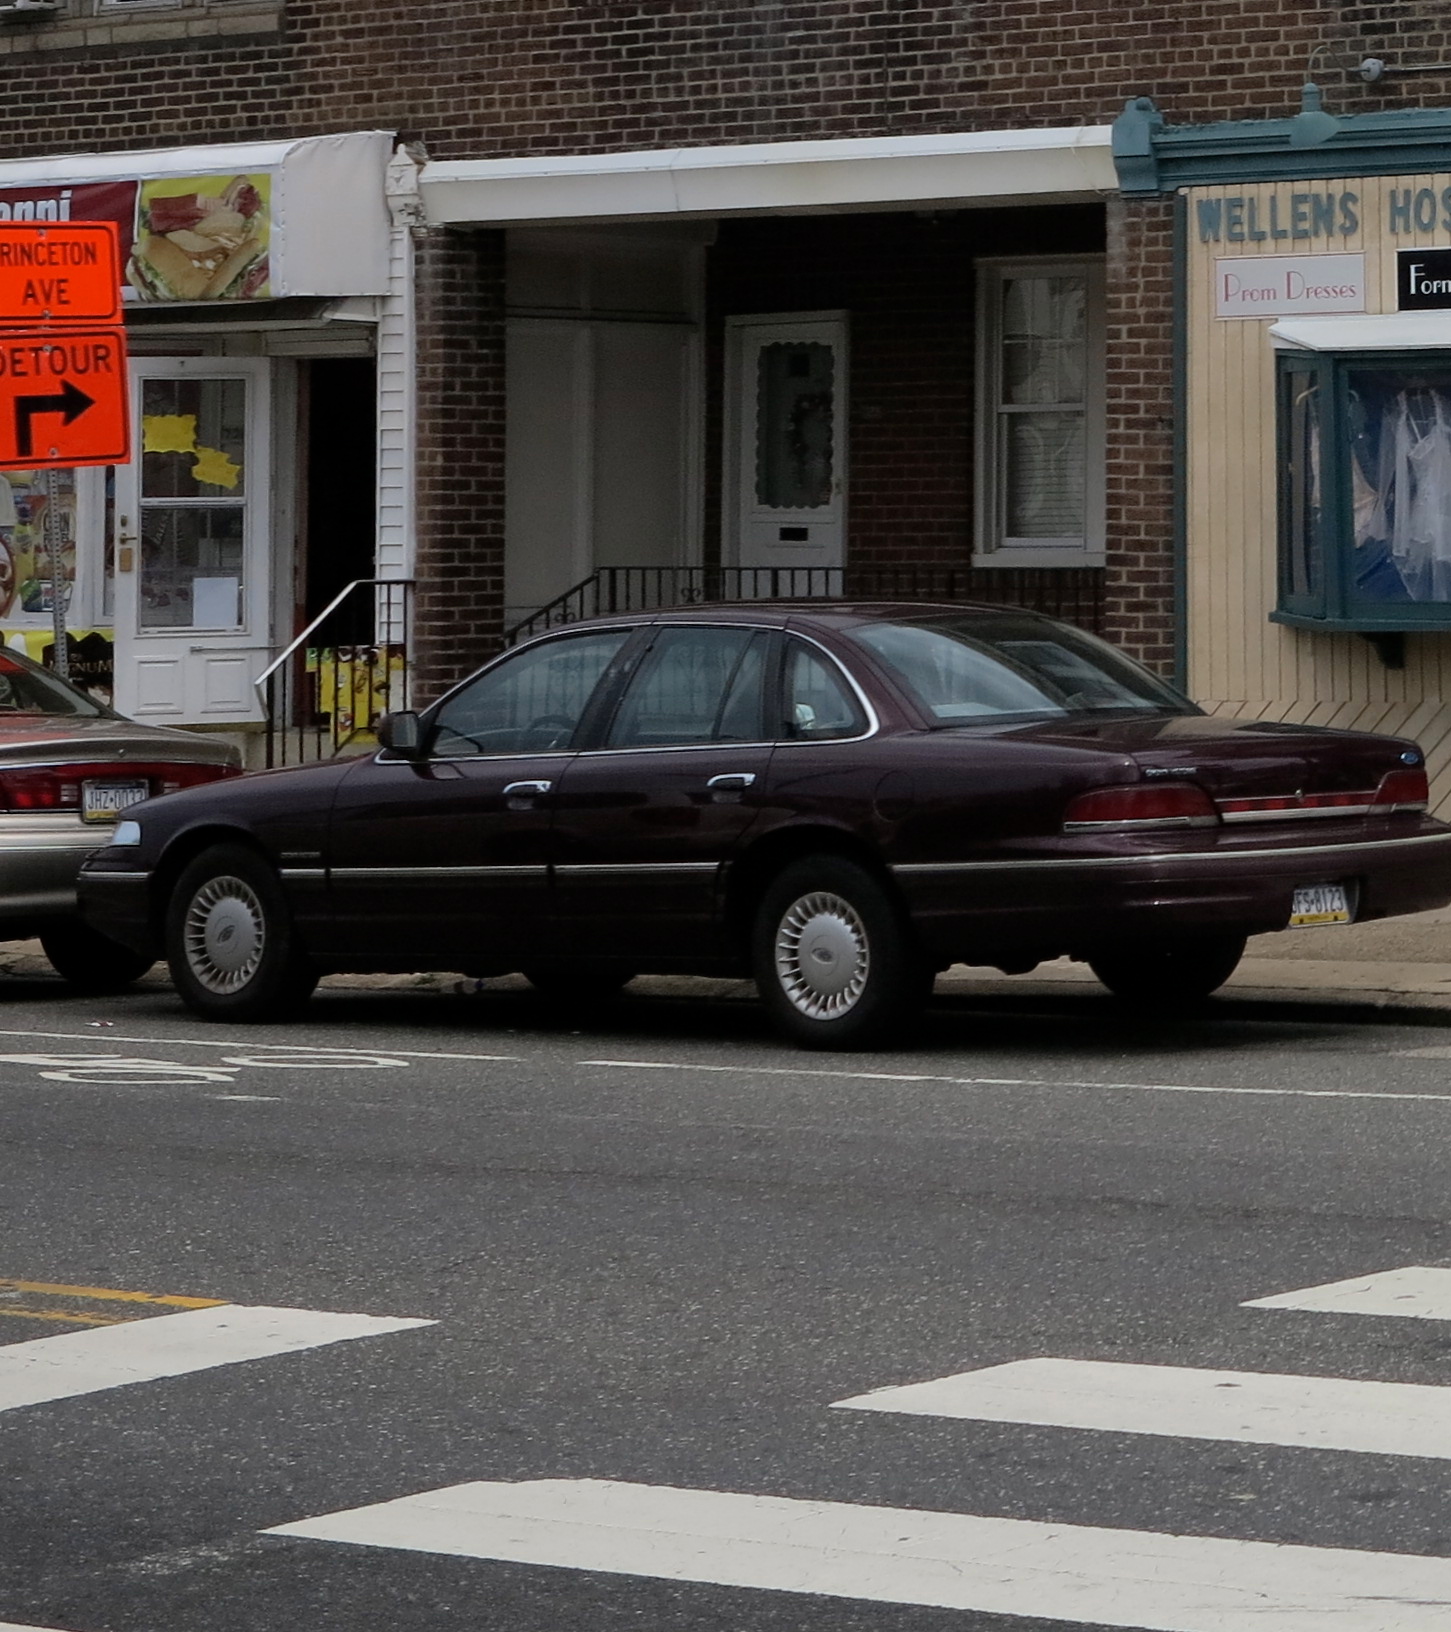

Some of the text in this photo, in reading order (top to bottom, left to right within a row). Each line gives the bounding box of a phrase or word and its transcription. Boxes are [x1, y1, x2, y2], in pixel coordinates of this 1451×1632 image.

[1196, 191, 1360, 243] WELLENS
[22, 279, 71, 305] AVE
[1223, 270, 1357, 302] Prom Dresses
[0, 344, 112, 377] ETOUR
